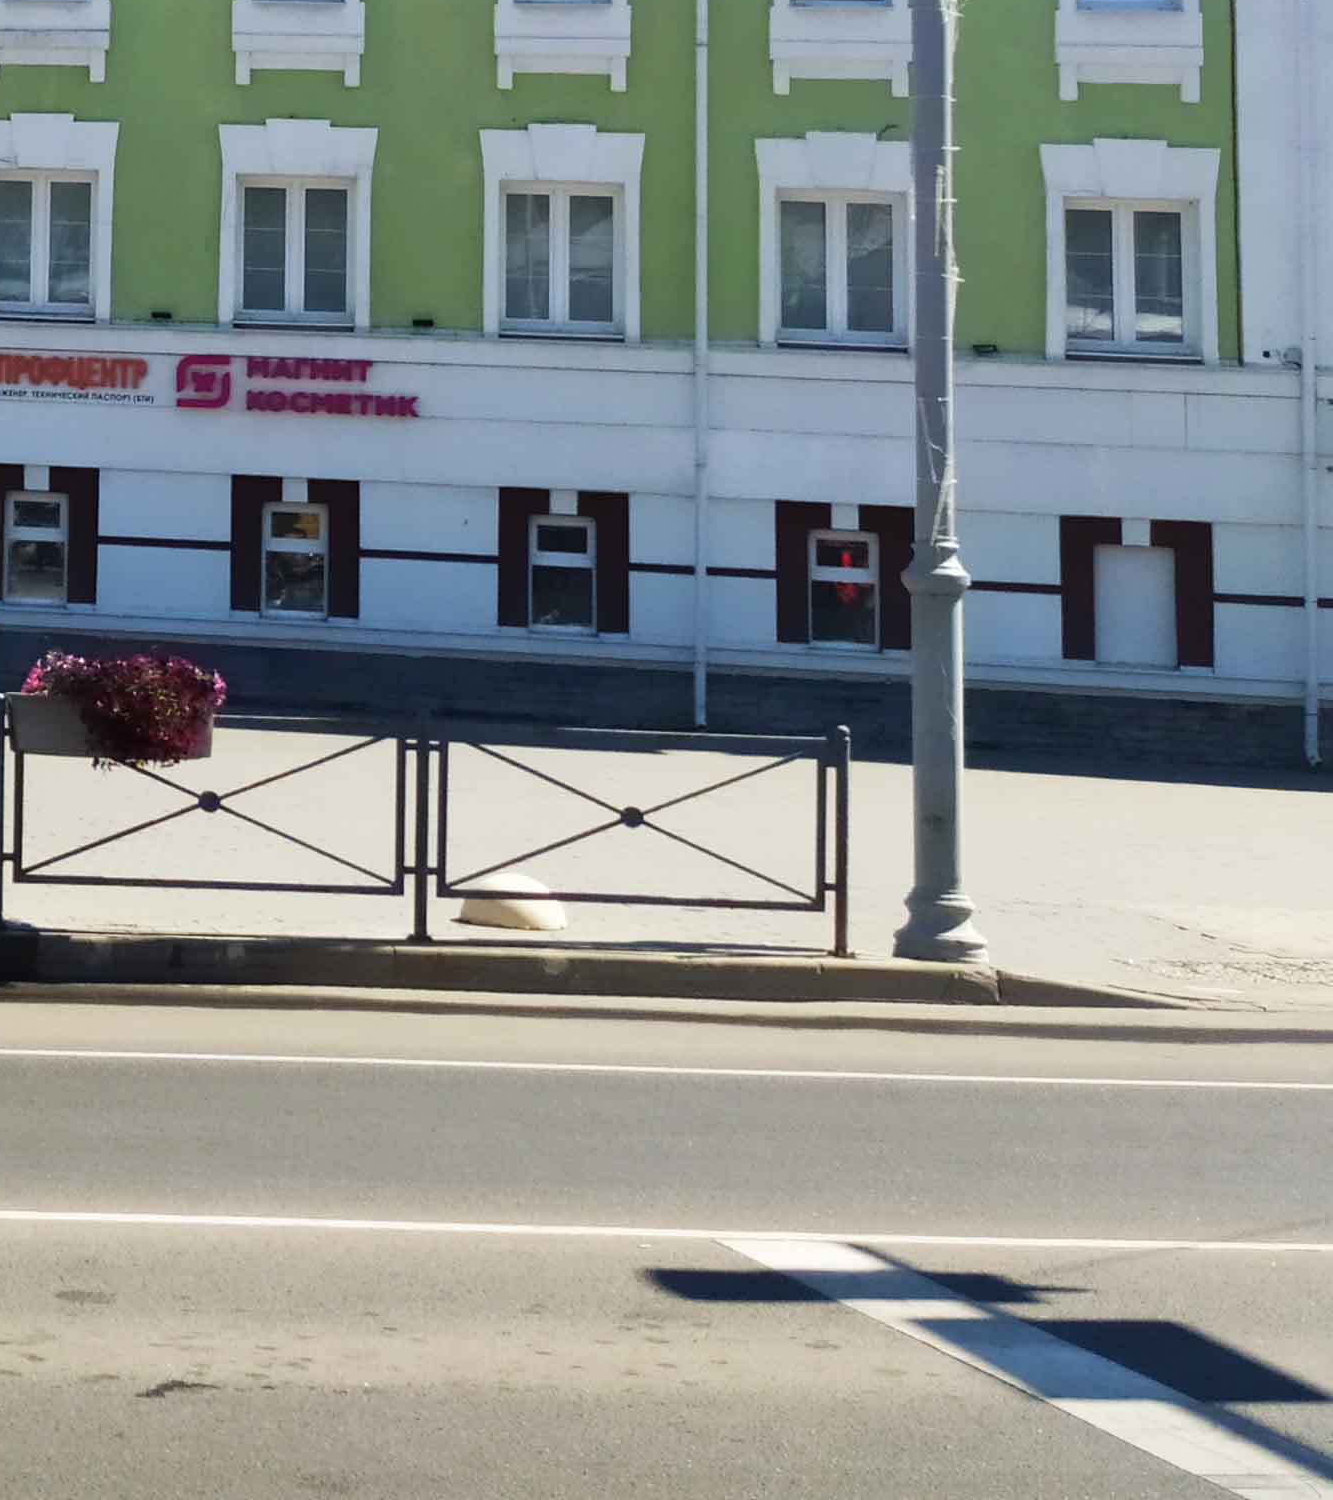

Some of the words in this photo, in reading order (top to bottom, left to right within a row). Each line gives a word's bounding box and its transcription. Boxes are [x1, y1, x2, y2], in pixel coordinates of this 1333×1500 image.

[246, 355, 373, 382] МАГНИТ
[31, 390, 90, 400] ТЕХНИЧЕСКИЙ
[91, 392, 131, 402] ПАСПОРТ
[245, 389, 420, 418] КОСМЕТИК
